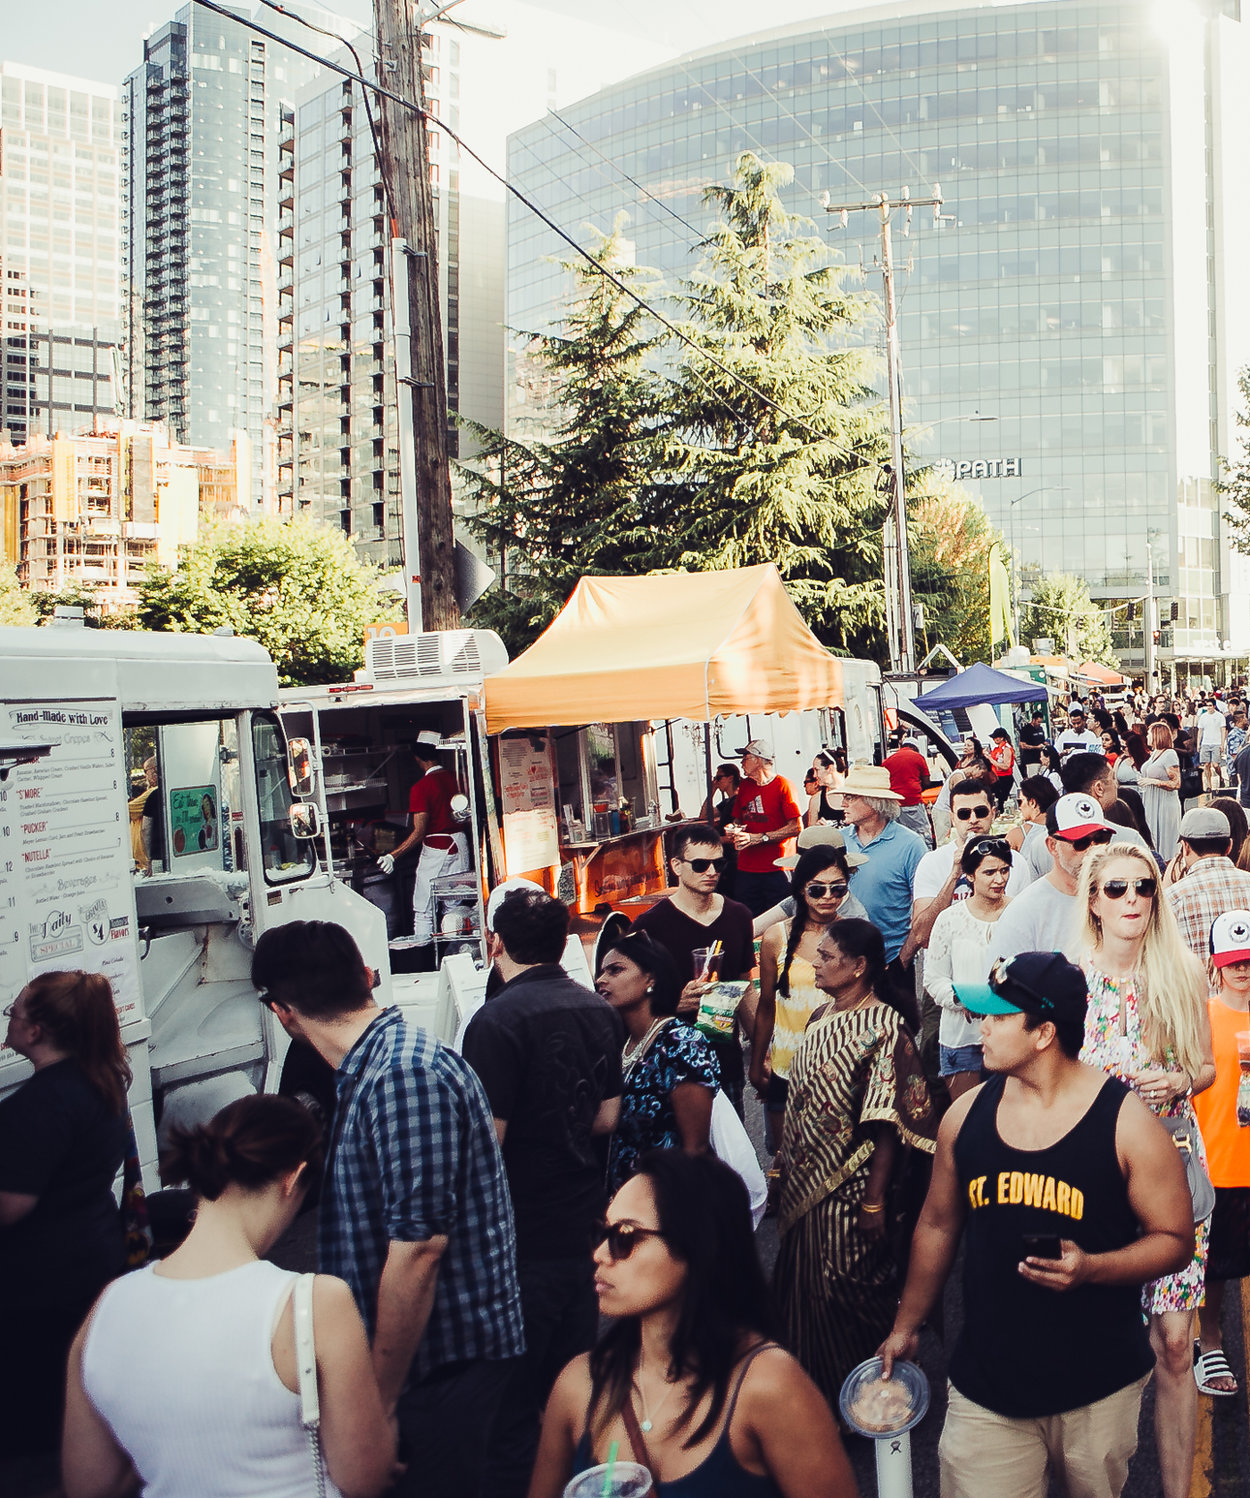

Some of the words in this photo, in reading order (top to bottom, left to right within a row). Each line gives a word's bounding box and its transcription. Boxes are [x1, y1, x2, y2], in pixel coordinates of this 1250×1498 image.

[956, 458, 1022, 480] PATH
[16, 710, 67, 724] Hand-Made
[68, 712, 88, 725] with
[89, 713, 108, 726] Love
[115, 811, 120, 822] 8
[2, 826, 11, 837] 10
[5, 860, 13, 872] 12
[8, 896, 16, 907] 11
[110, 928, 130, 940] Flavors
[968, 1176, 990, 1209] ST.
[997, 1171, 1084, 1221] EDWARD
